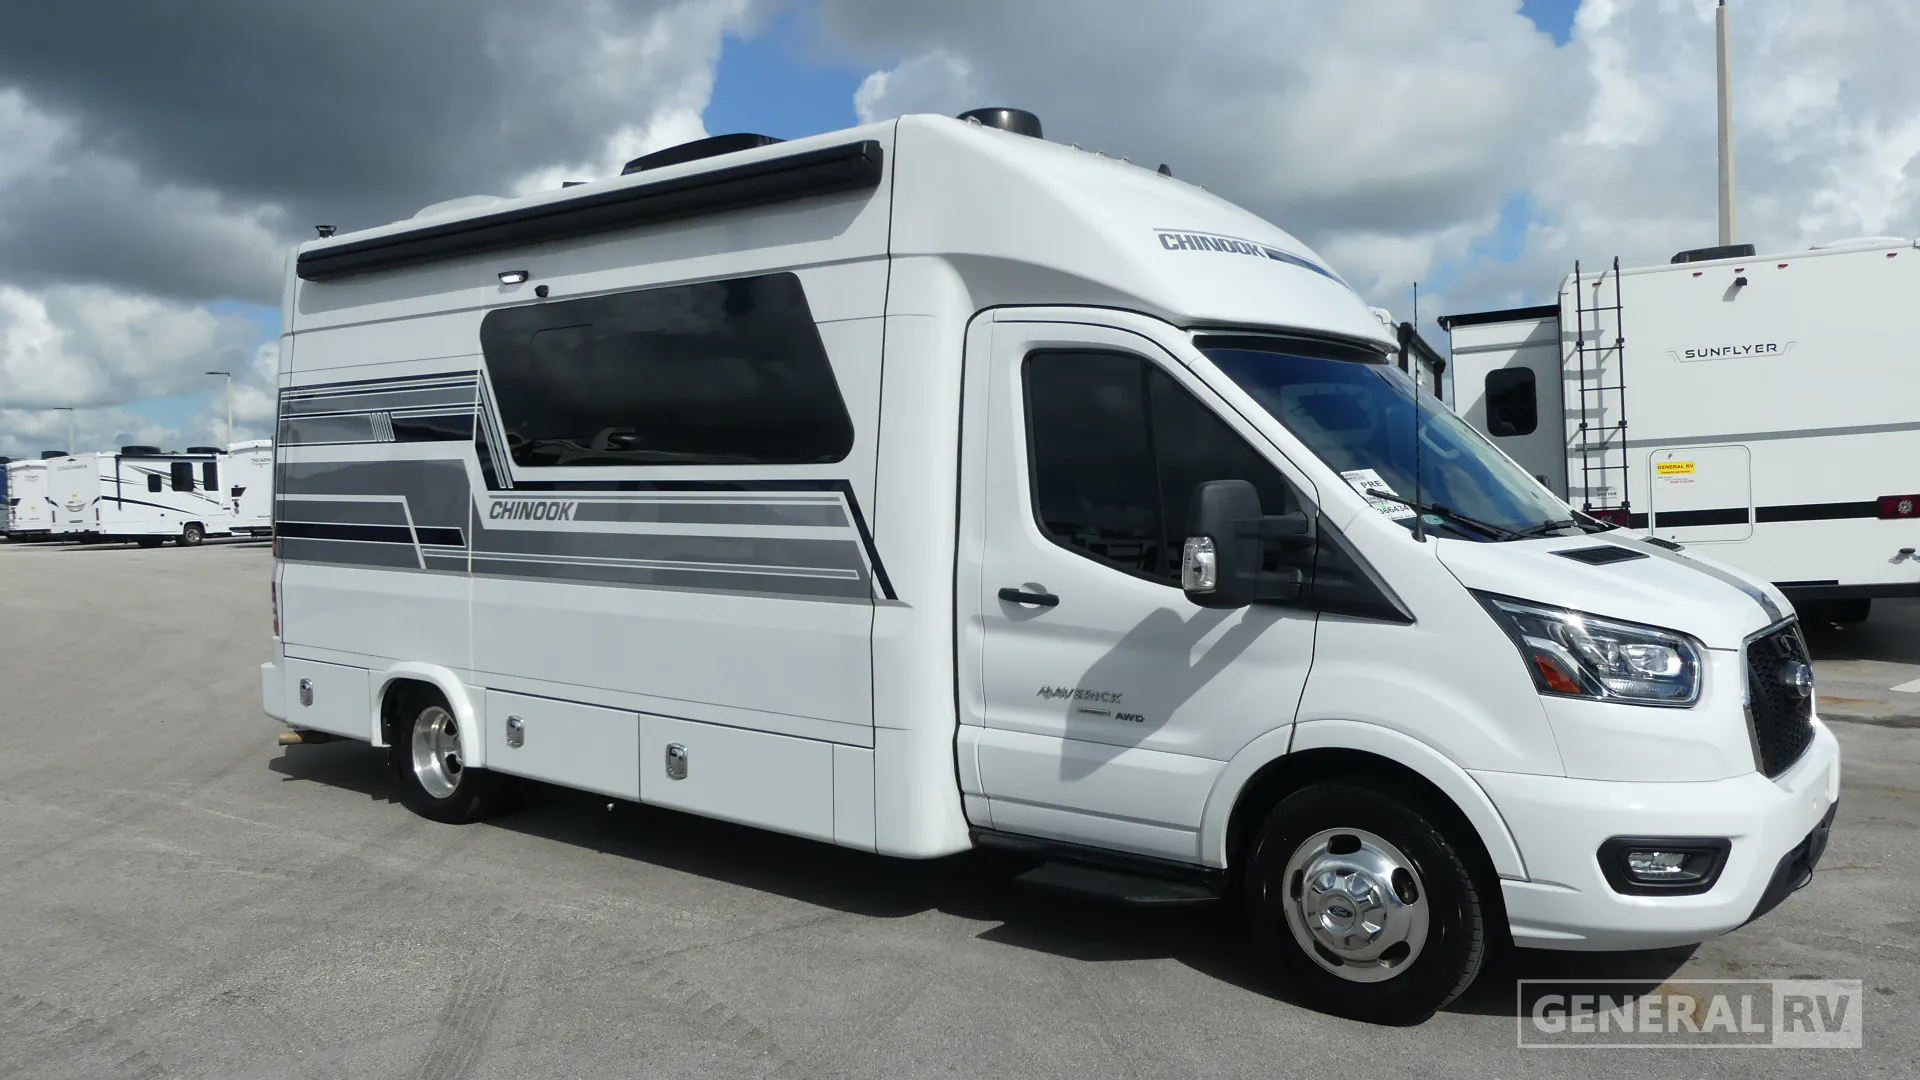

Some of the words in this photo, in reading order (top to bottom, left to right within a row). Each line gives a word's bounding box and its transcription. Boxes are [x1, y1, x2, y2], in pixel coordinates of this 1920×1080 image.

[1158, 233, 1266, 258] CHINOOK
[1685, 343, 1777, 358] SUNFLYER
[1360, 480, 1383, 488] PRE
[490, 501, 574, 521] CHINOOK
[1037, 686, 1122, 704] MAVERICK
[1115, 712, 1145, 723] AWD
